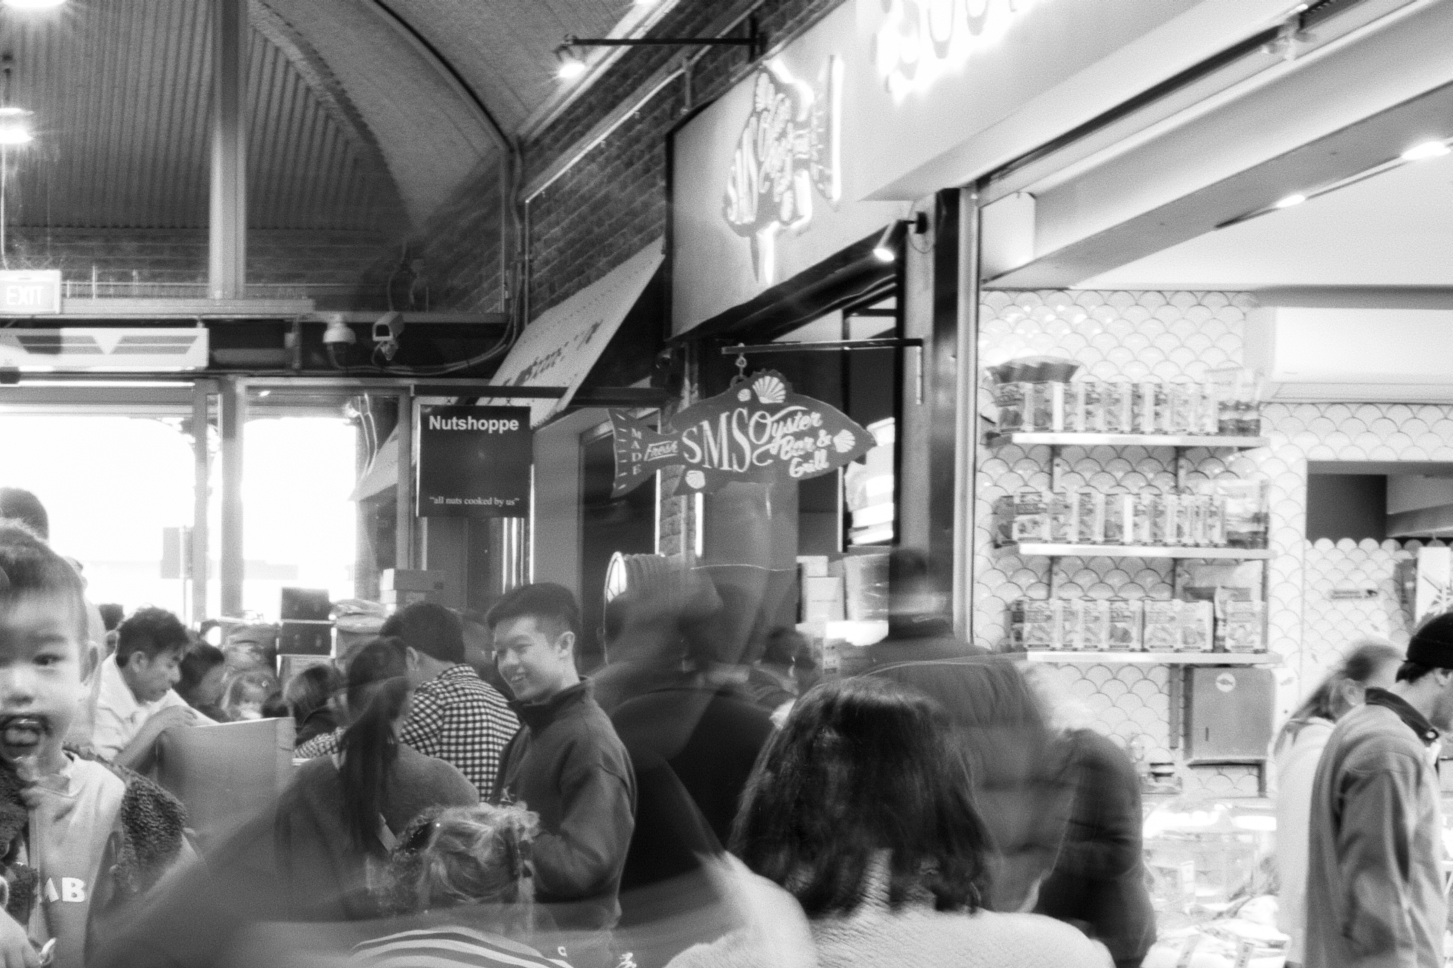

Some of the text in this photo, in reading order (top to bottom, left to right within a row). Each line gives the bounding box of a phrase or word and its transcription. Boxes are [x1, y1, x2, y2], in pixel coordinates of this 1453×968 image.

[7, 285, 44, 305] EXIT
[429, 415, 519, 434] Nutshoppe
[749, 406, 822, 462] Oyster
[682, 407, 751, 473] SMS
[816, 429, 833, 447] &
[789, 449, 829, 477] Grill
[464, 497, 492, 505] cooked
[494, 497, 504, 507] by
